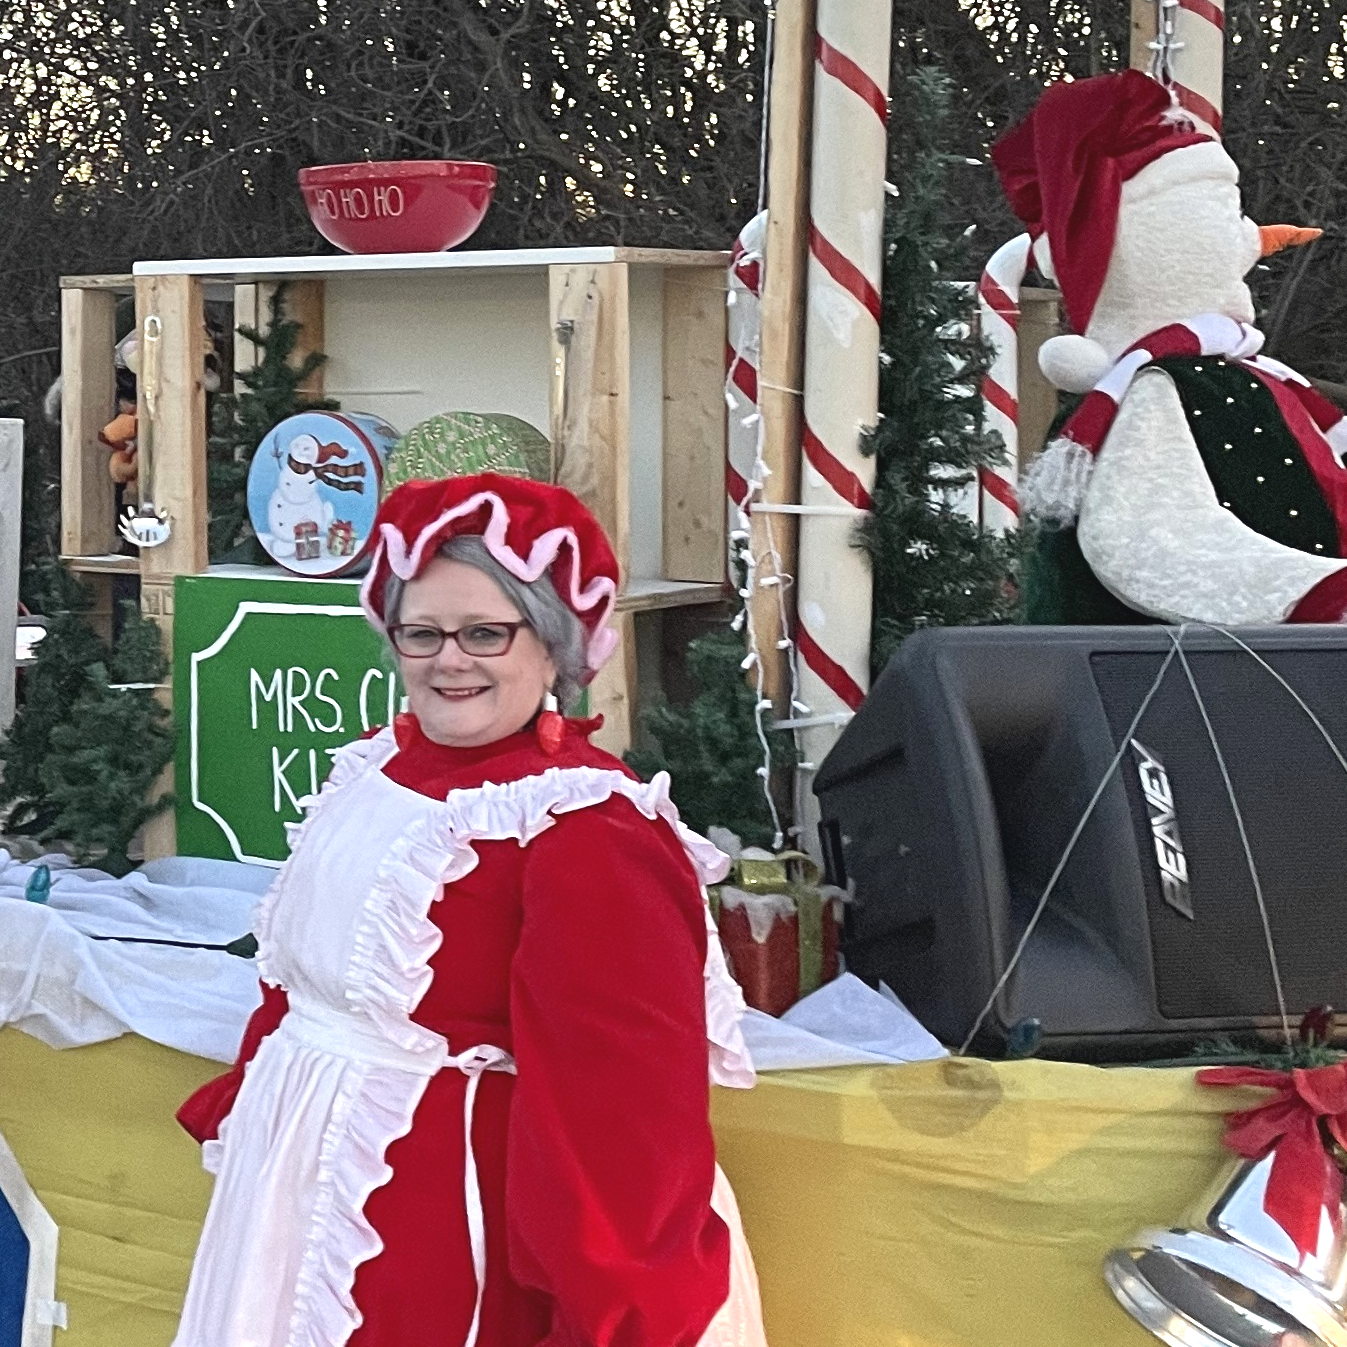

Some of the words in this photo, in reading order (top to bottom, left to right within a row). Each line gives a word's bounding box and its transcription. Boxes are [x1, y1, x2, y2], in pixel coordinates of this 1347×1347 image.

[315, 188, 339, 220] HO
[340, 187, 370, 219] HO
[373, 185, 405, 216] HO
[250, 666, 345, 733] MRS.
[1130, 736, 1195, 921] PEAVEY
